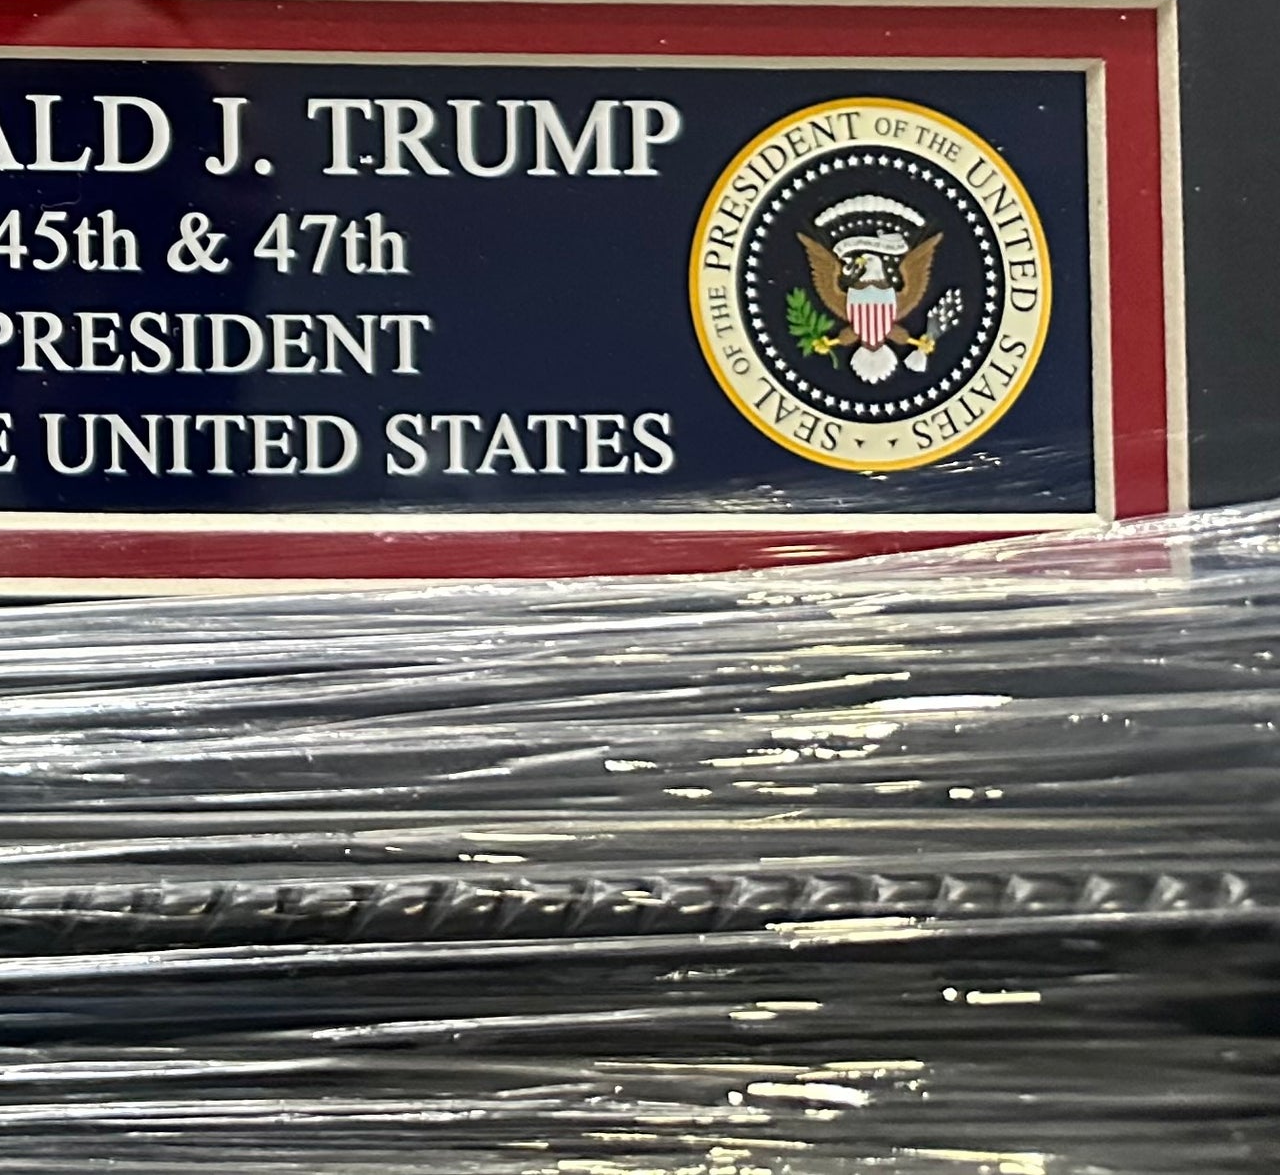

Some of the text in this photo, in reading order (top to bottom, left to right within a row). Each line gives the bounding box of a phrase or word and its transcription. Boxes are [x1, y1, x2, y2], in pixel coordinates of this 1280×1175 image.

[204, 97, 274, 177] J.
[306, 97, 682, 178] TRUMP
[165, 211, 230, 273] &
[252, 212, 411, 276] 47th
[704, 111, 1038, 451] SEAL OF THE PRESIDENT OF THE UNITED STATES
[38, 412, 360, 476] UNITED
[384, 411, 675, 476] STATES
